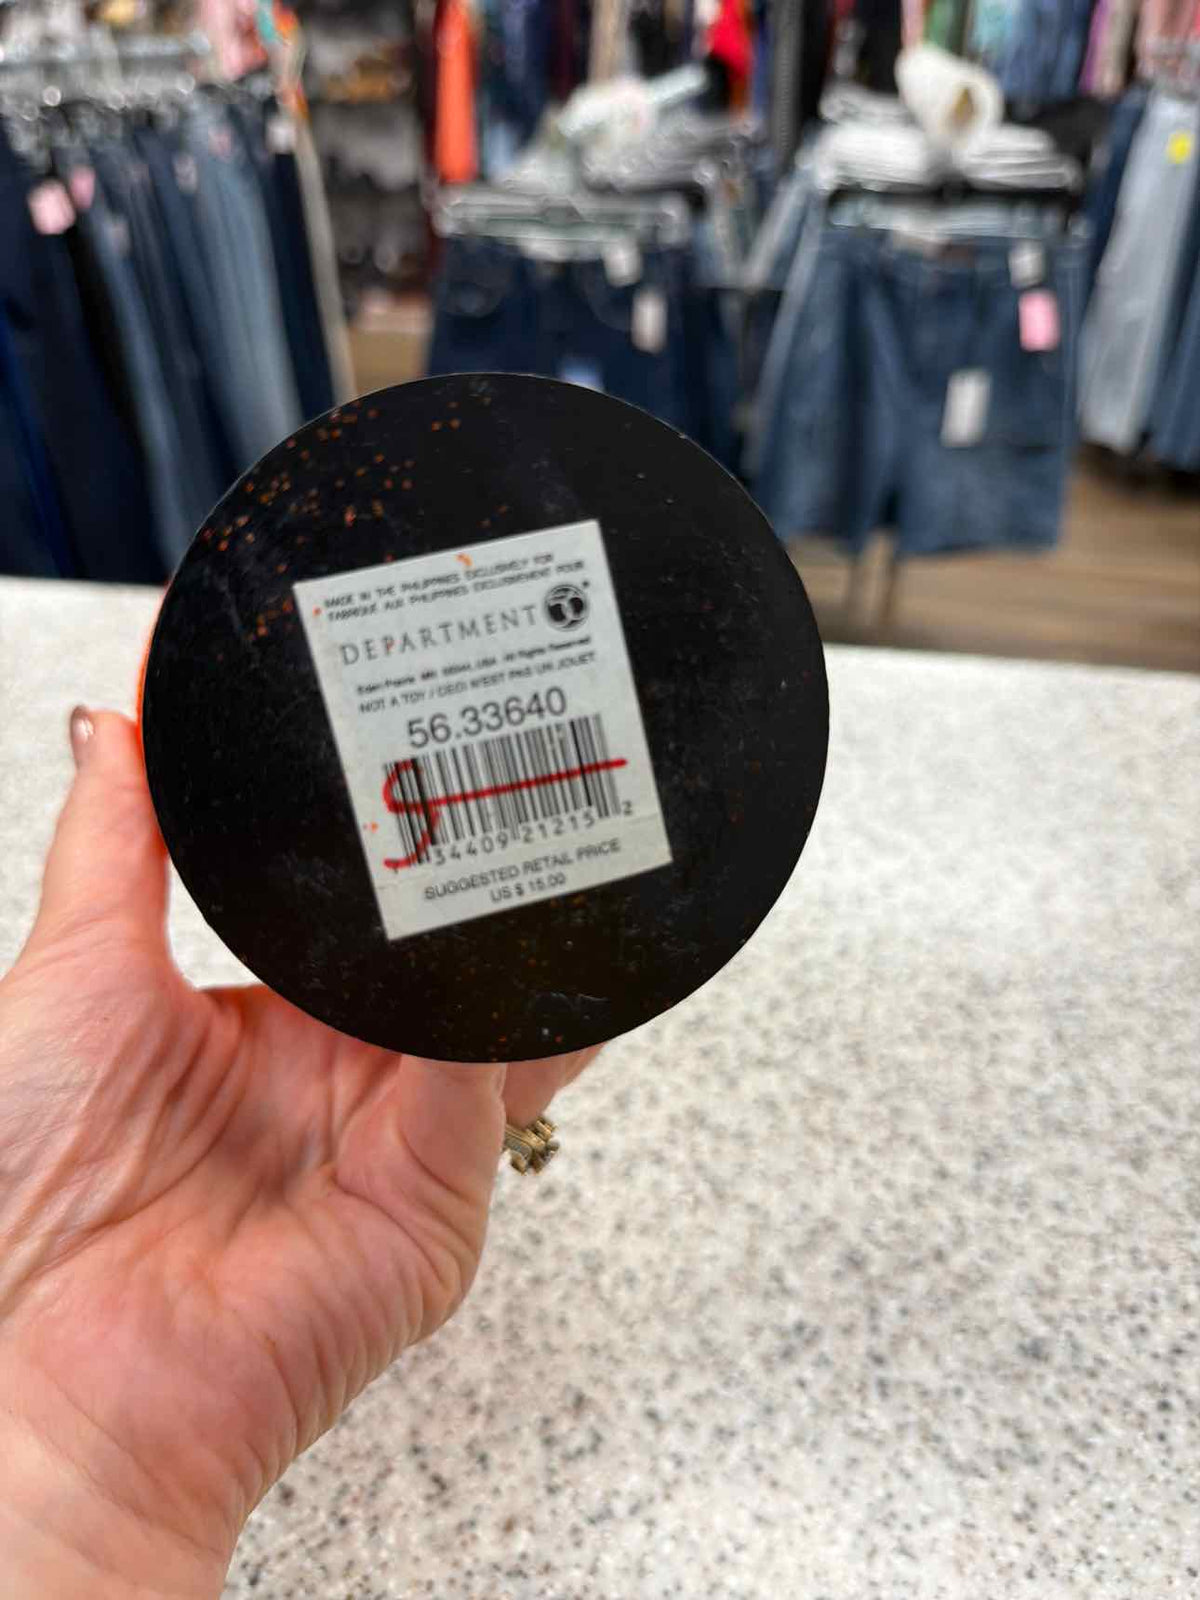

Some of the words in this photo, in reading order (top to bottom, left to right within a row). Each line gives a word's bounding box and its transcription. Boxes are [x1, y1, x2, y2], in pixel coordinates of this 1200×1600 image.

[340, 604, 535, 665] DEPARTMENT
[358, 697, 385, 713] NOT
[390, 696, 398, 707] A
[400, 690, 425, 703] TOY
[407, 686, 566, 748] 56.33640
[423, 864, 520, 900] SUGGESTED
[521, 852, 573, 874] RETAIL
[575, 837, 620, 860] PRICE
[489, 885, 512, 903] US
[514, 882, 524, 896] $
